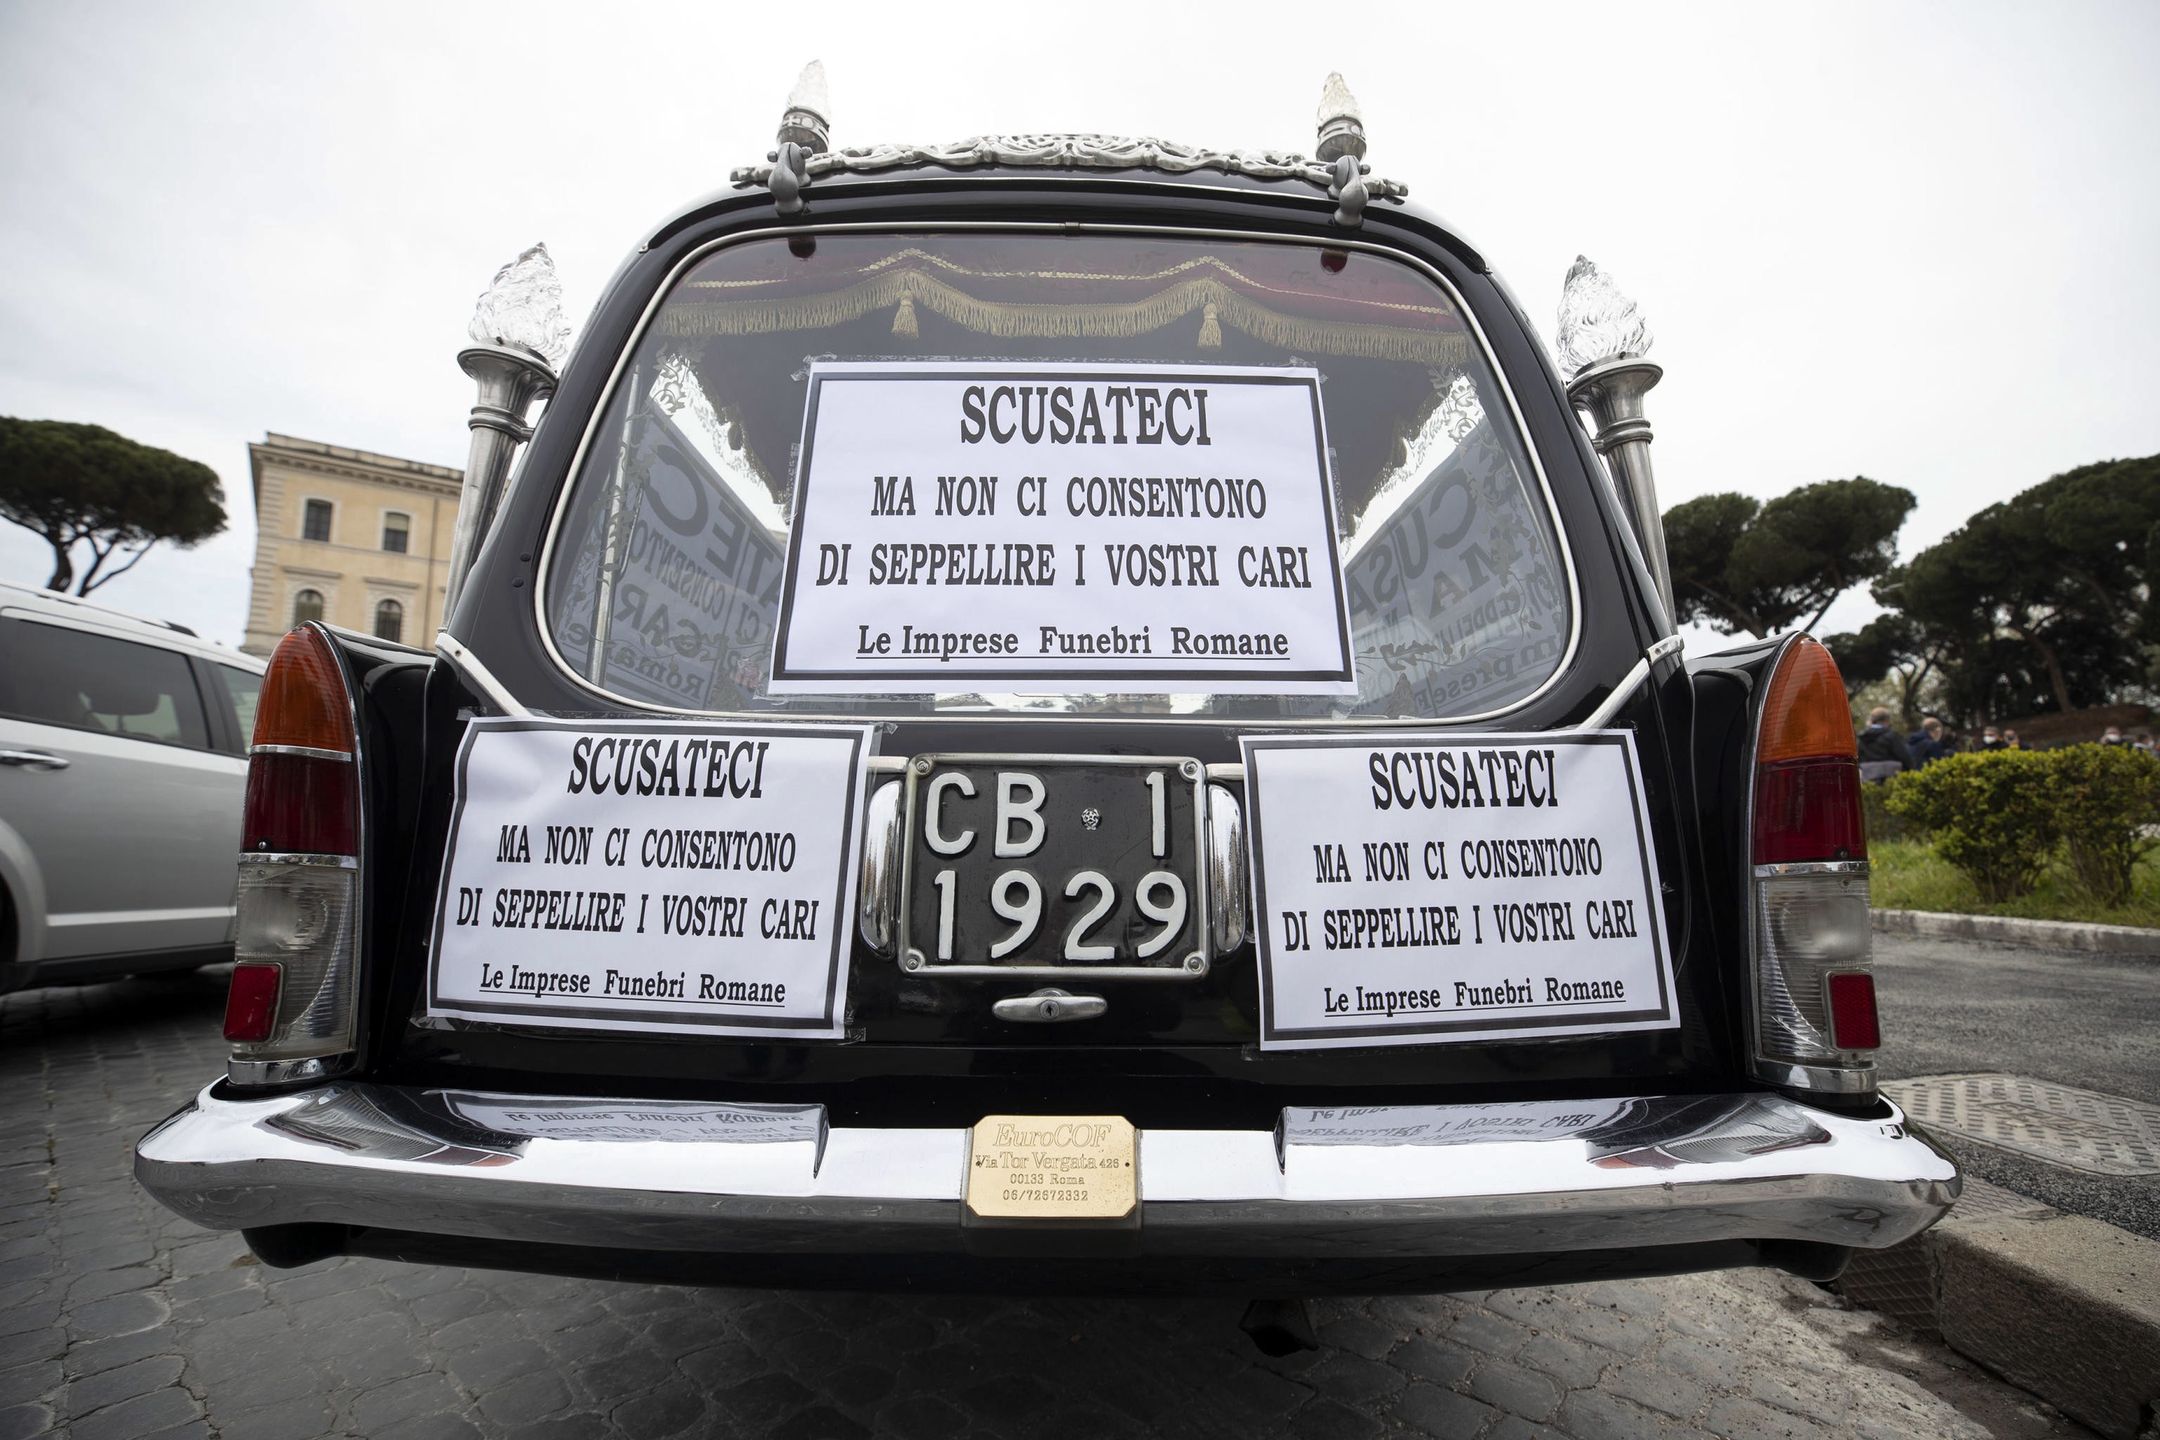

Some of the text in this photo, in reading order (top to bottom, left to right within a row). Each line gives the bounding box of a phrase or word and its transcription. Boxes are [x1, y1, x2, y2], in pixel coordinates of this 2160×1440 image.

[960, 385, 1212, 446] SCUSATECI
[871, 476, 1267, 519] MA NON CI CONSENTONO
[815, 543, 1312, 589] DI SEPPELLIRE I VOSTRI CARI
[857, 624, 1289, 662] Le Imprese Funebri Romane
[567, 737, 769, 799] SCUSATECI
[1369, 749, 1559, 810] SCUSATECI
[924, 771, 1165, 858] CB 1
[496, 825, 797, 873] MA NON CI CONSENTONO
[1313, 836, 1602, 884] MA NON CI CONSENTONO
[457, 887, 820, 941] DI SEPPELLIRE I VOSTRI CARI
[934, 869, 1187, 961] 1929
[1282, 899, 1638, 951] DI SEPPELLIRE I VOSTRI CARI
[480, 963, 786, 1003] Le Imprese Funebri Romane
[1324, 976, 1625, 1018] Le Imprese Funebri Romane
[992, 1123, 1111, 1148] EuroCOF
[1000, 1151, 1029, 1169] Tor
[1031, 1151, 1097, 1172] Vergata
[1010, 1173, 1085, 1185] 00133 Roma
